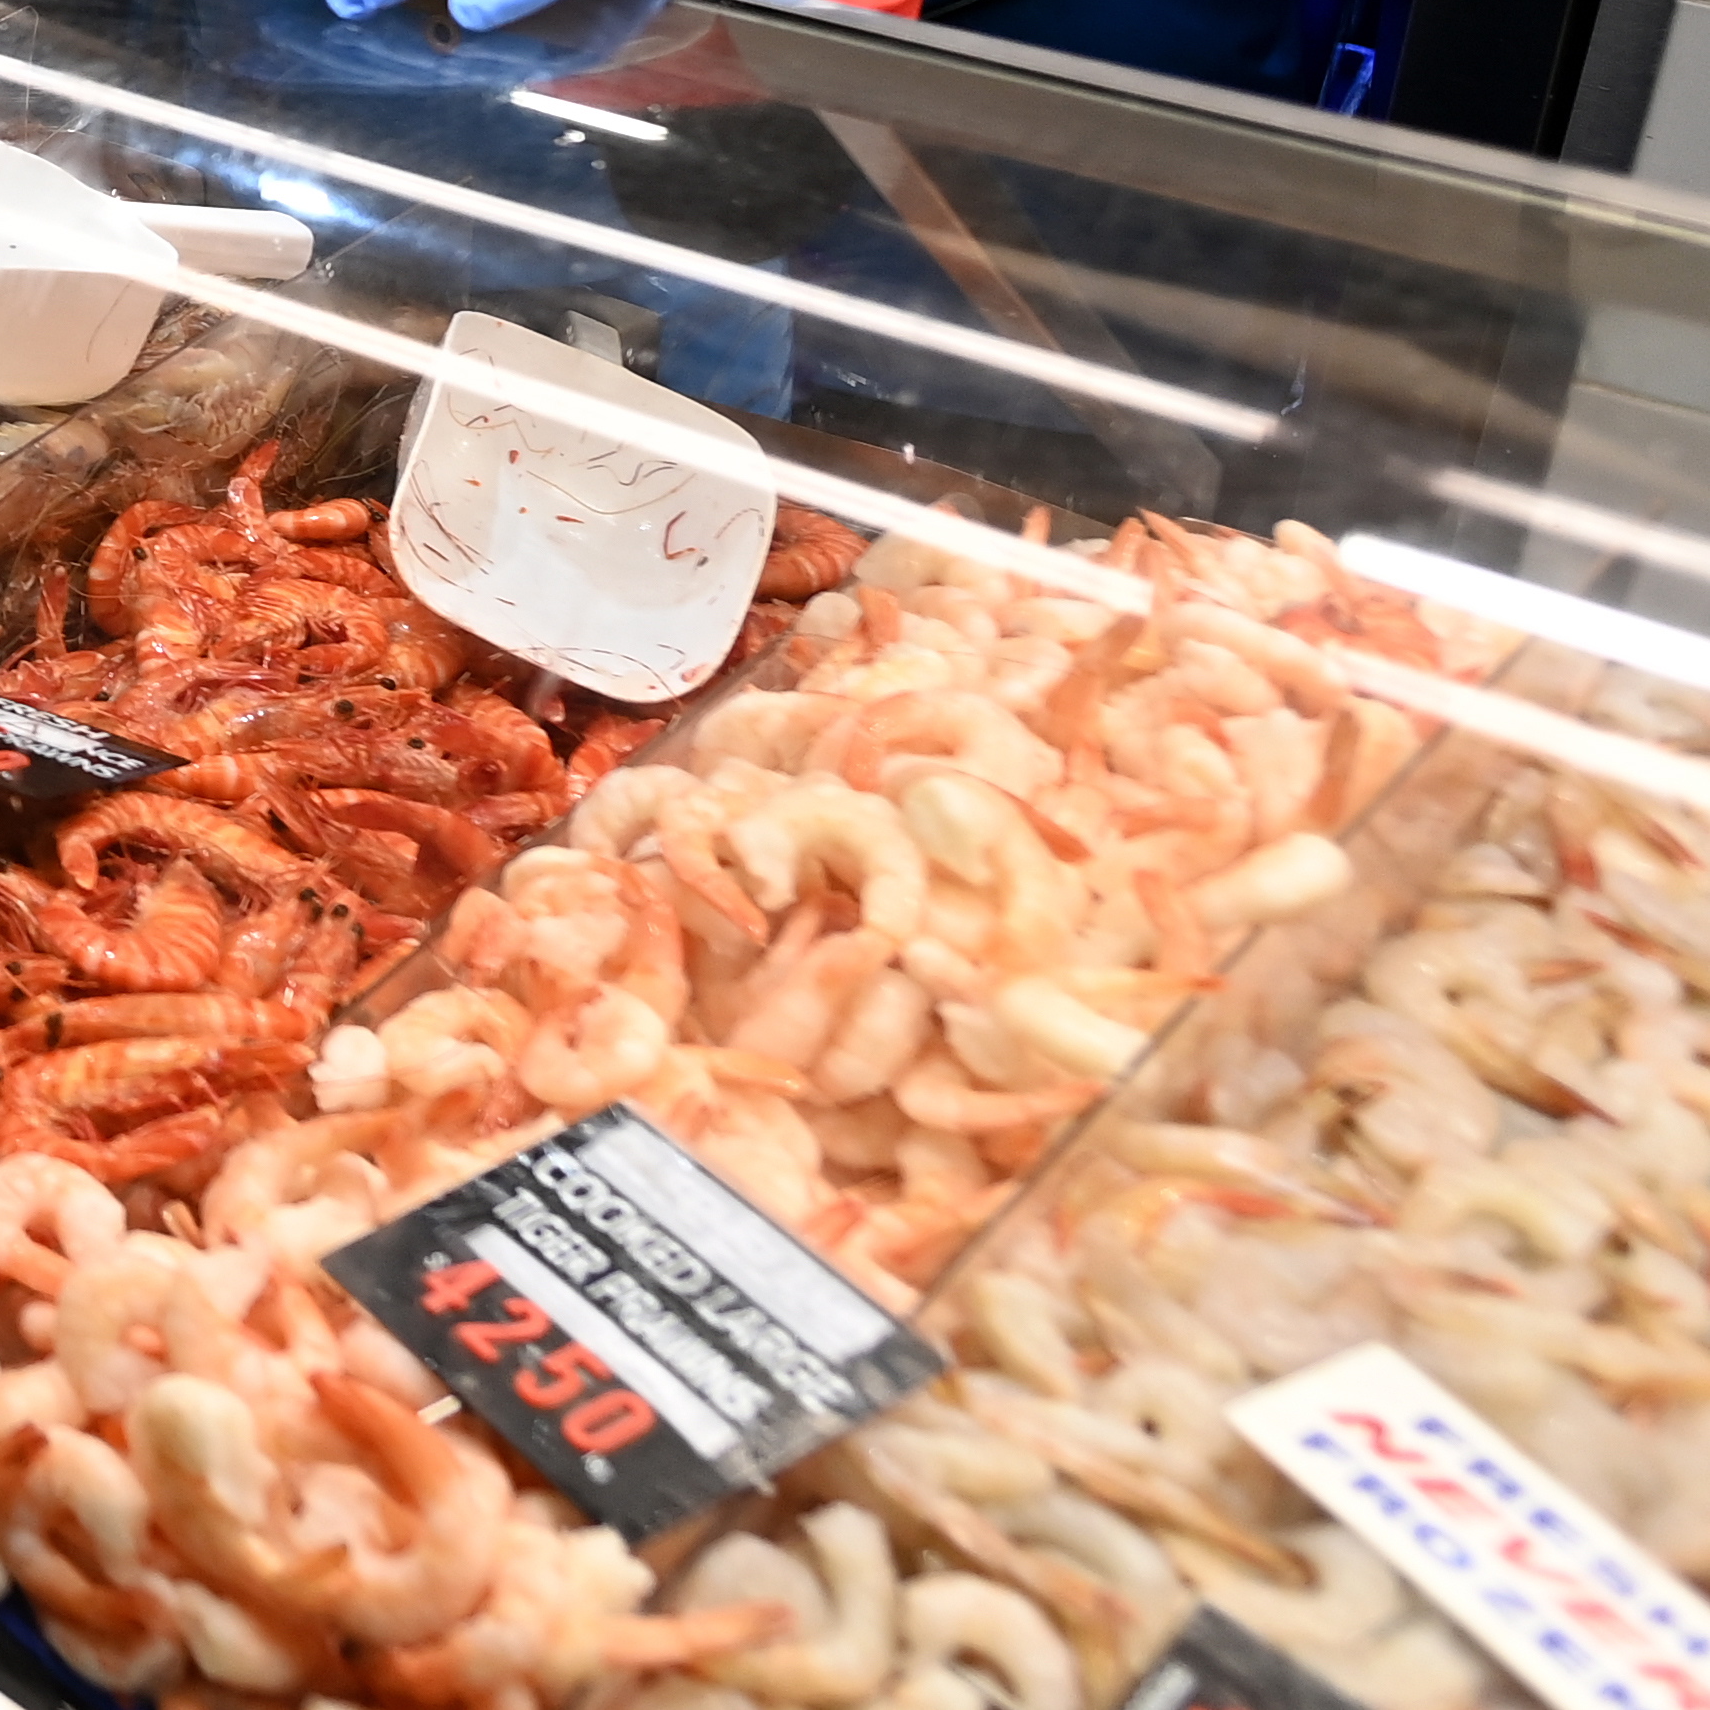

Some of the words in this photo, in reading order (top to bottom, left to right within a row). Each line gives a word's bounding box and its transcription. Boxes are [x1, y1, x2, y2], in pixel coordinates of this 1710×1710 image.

[492, 1187, 612, 1285] TIGER
[583, 1269, 774, 1423] PRAWNS
[528, 1146, 712, 1295] COOKED
[690, 1283, 856, 1416] LARGE
